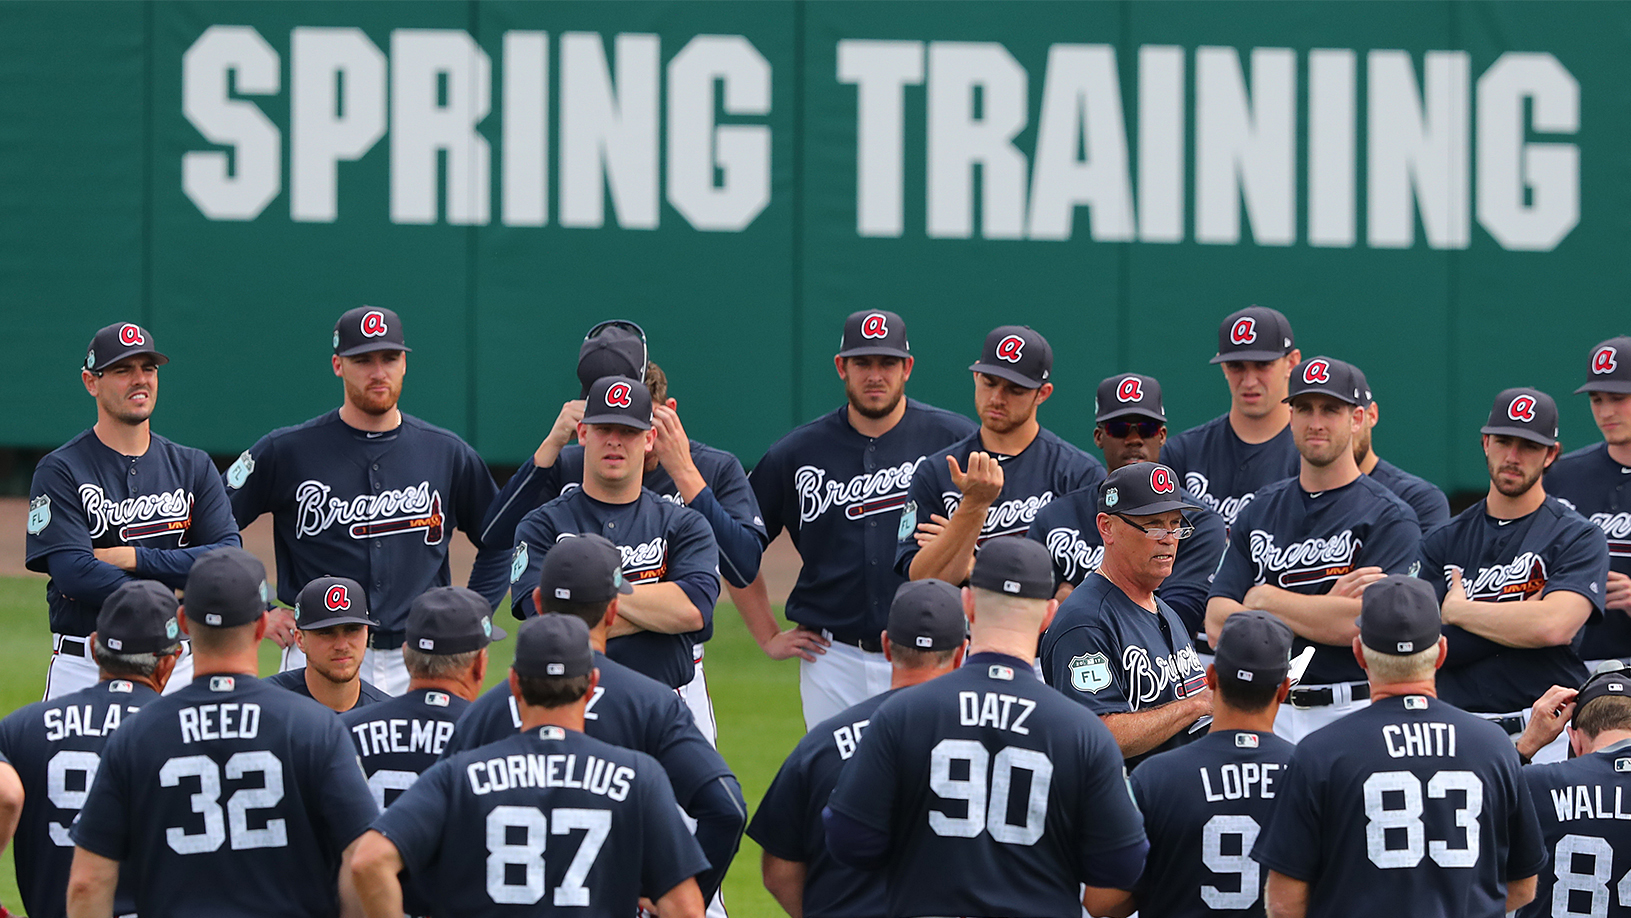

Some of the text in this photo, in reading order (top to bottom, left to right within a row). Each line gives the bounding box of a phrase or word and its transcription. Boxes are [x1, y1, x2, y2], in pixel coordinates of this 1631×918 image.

[181, 24, 1581, 252] SPRING TRAINING
[32, 511, 44, 527] FL
[78, 483, 188, 539] Braves
[296, 480, 430, 540] Braves
[1046, 527, 1106, 582] Bra
[1249, 529, 1353, 586] Braves
[1081, 670, 1102, 683] FL
[178, 703, 261, 744] REED
[352, 719, 455, 757] TREMB
[959, 691, 1037, 735] DATZ
[1382, 722, 1456, 758] CHITI
[158, 750, 288, 855] 32
[467, 754, 636, 803] CORNELIUS
[928, 738, 1054, 846] 90
[1200, 763, 1288, 802] LOPE
[1550, 785, 1631, 822] WALL
[1363, 770, 1484, 869] 83
[485, 805, 613, 907] 87
